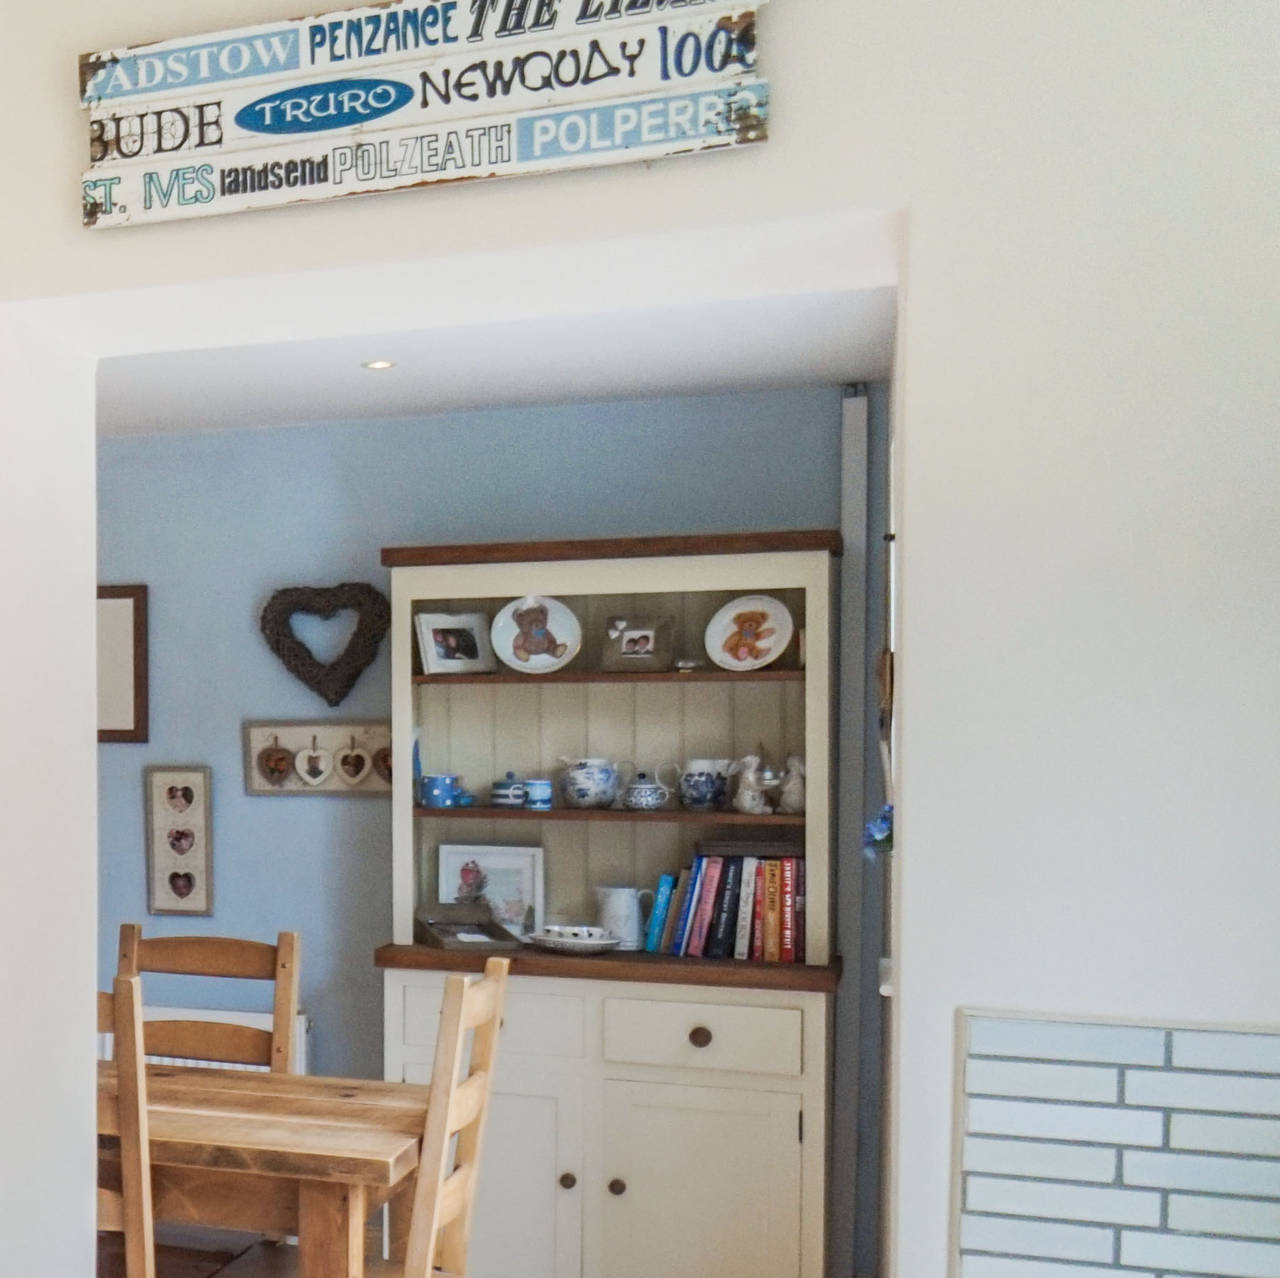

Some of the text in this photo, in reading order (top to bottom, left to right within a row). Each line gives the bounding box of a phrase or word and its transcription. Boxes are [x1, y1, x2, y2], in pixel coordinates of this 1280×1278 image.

[309, 1, 459, 65] PENZANCE
[466, 0, 558, 42] THE
[90, 101, 223, 161] BUDE
[255, 84, 397, 126] TRURO
[419, 38, 646, 108] NEWQUAY
[143, 163, 216, 210] IVES
[220, 154, 329, 196] landsend
[332, 123, 512, 185] POLZEATH
